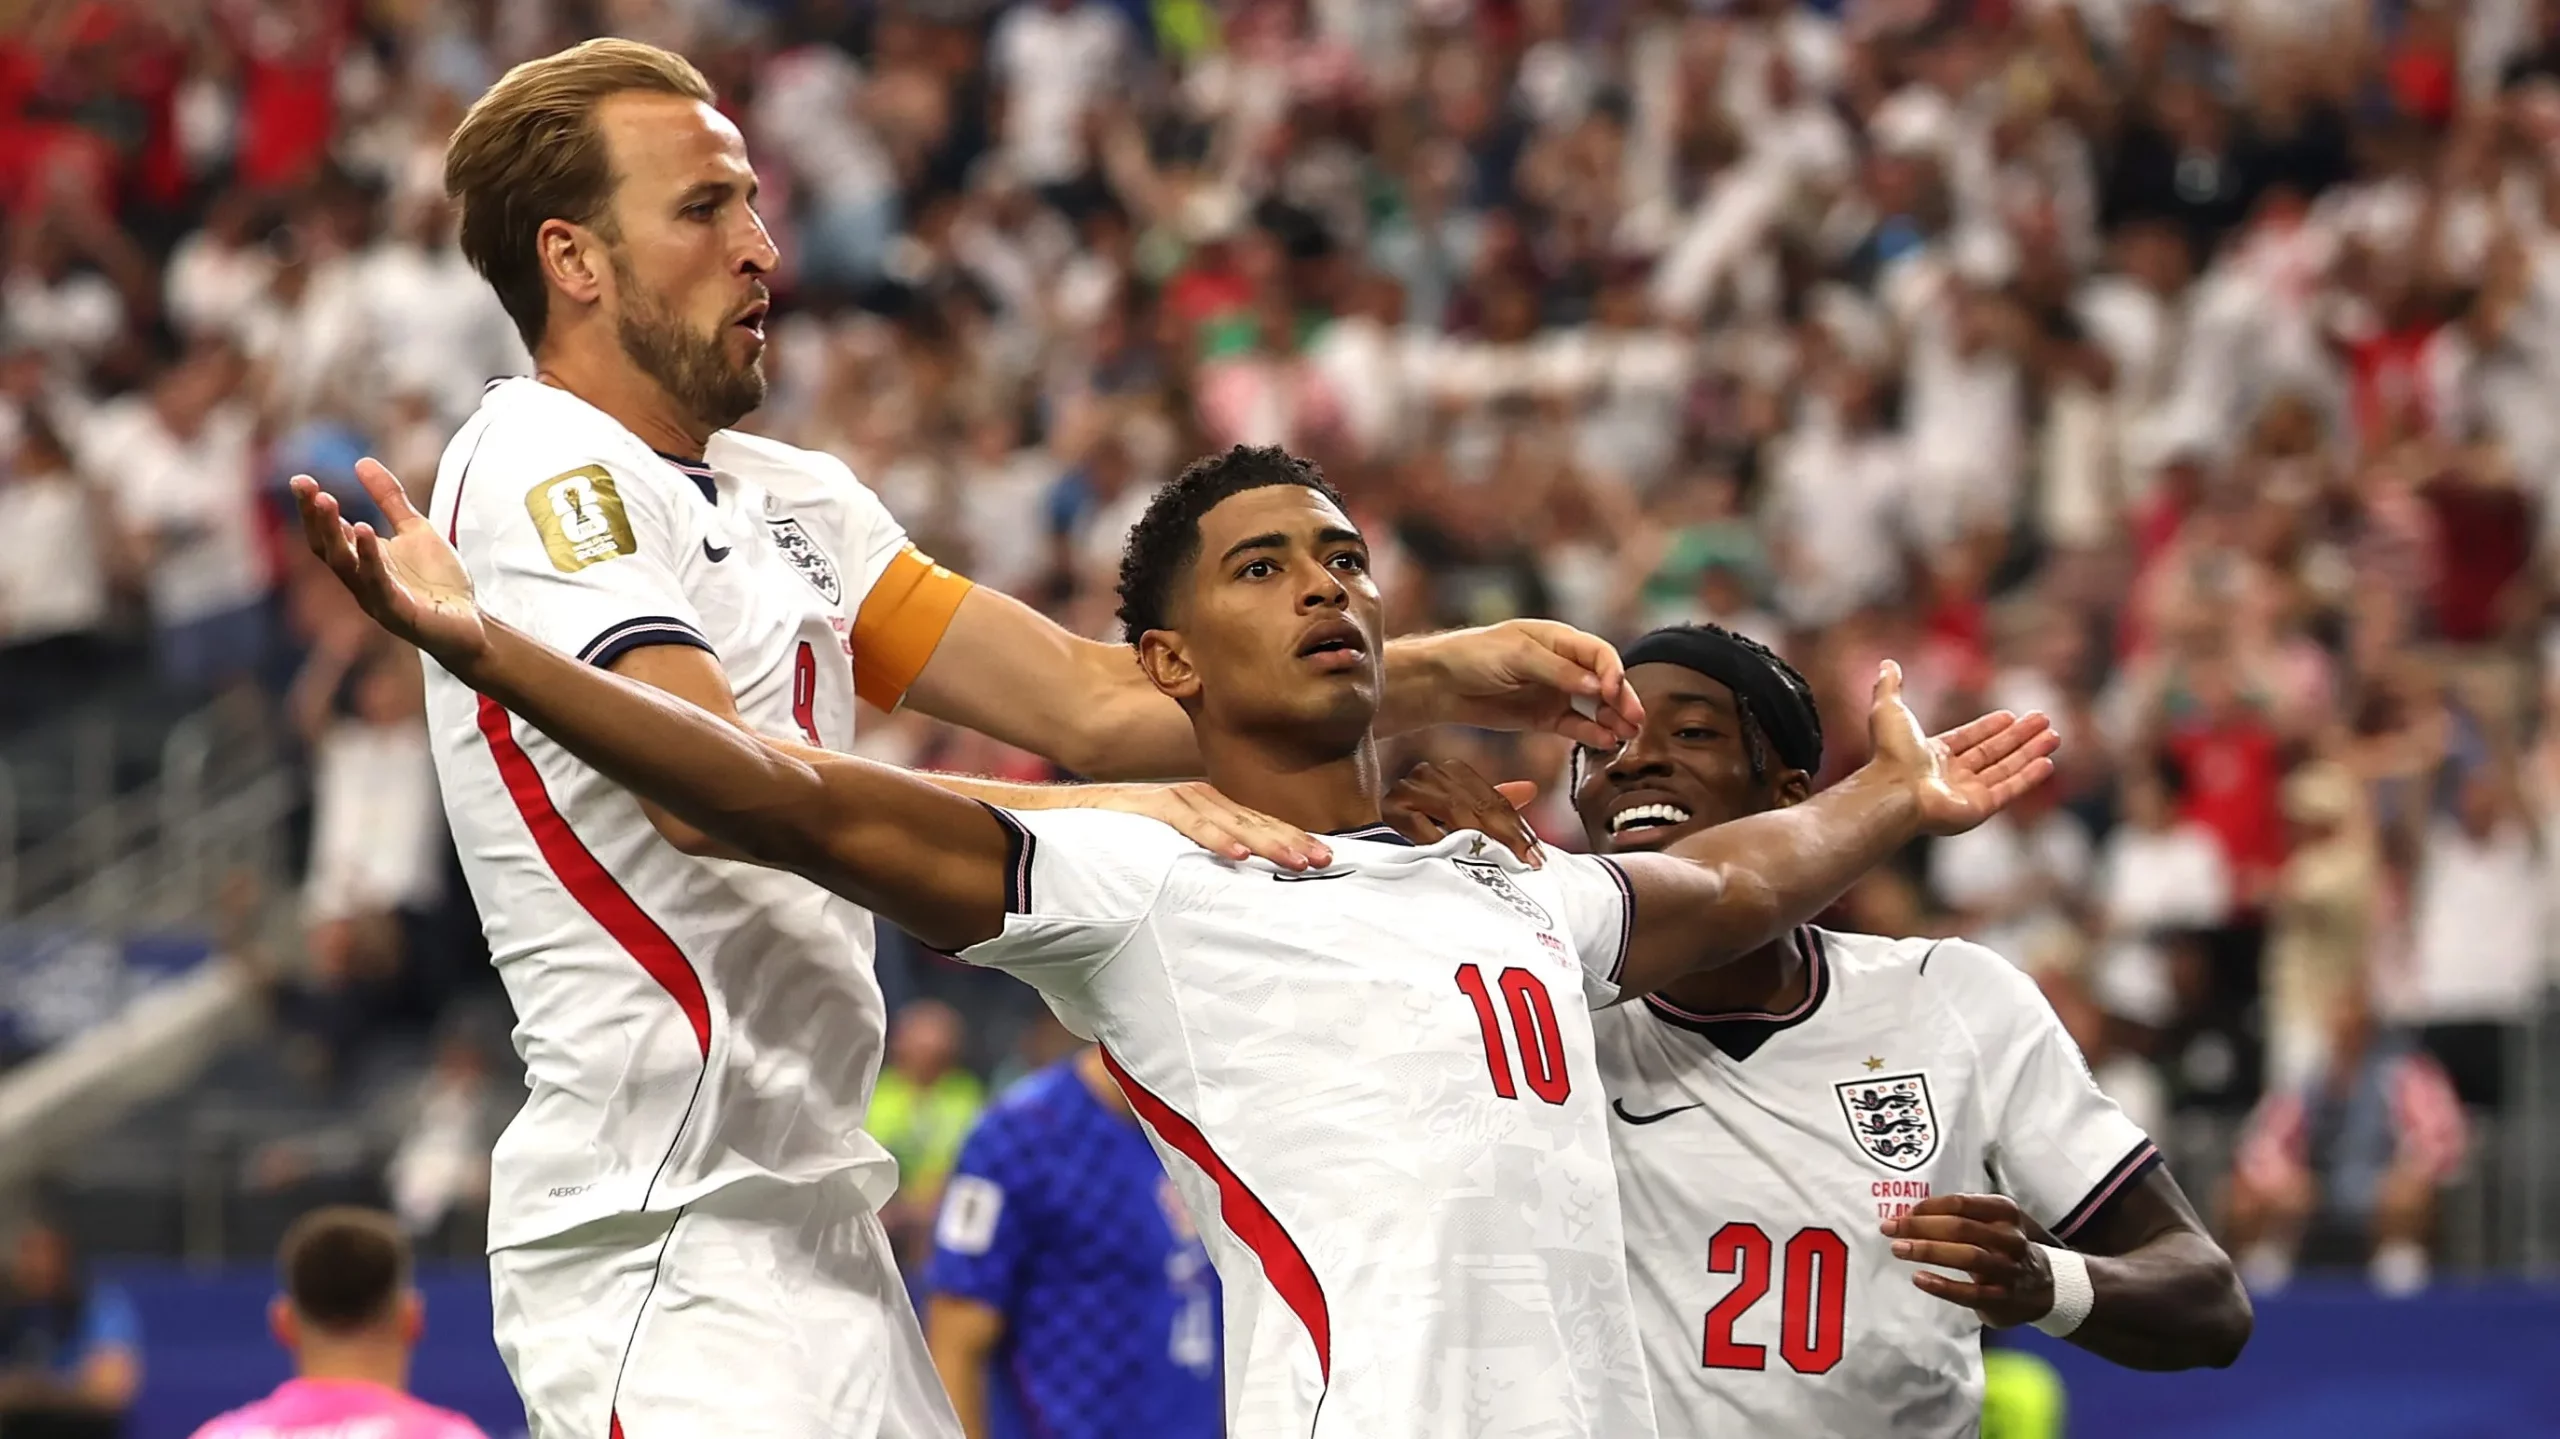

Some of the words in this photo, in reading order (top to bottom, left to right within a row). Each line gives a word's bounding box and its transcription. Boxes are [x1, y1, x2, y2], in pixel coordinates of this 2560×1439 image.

[793, 640, 822, 749] 9
[1454, 963, 1571, 1106] 10
[1872, 1181, 1930, 1198] CROATIA
[1702, 1221, 1849, 1375] 20
